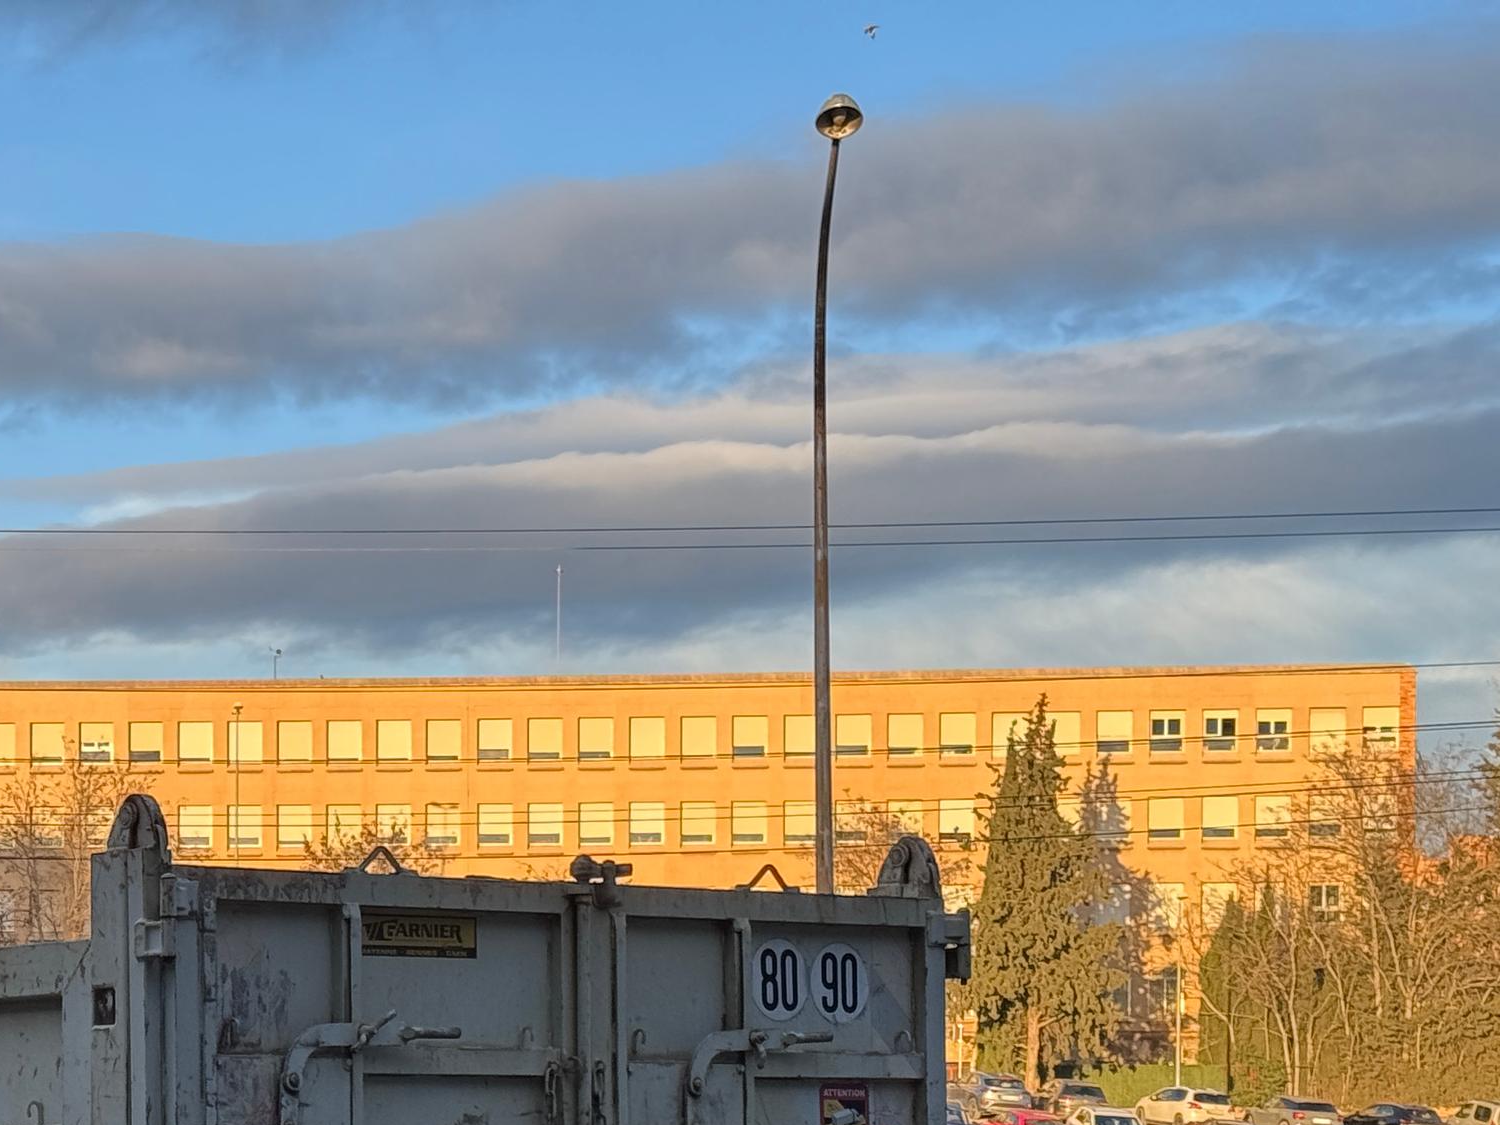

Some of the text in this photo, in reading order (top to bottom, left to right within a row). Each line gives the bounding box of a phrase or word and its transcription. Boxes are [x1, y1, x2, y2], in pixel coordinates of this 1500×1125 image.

[381, 919, 463, 944] GARNIER
[760, 948, 799, 1012] 80
[821, 952, 858, 1014] 90
[823, 1088, 866, 1097] ATTENTION
